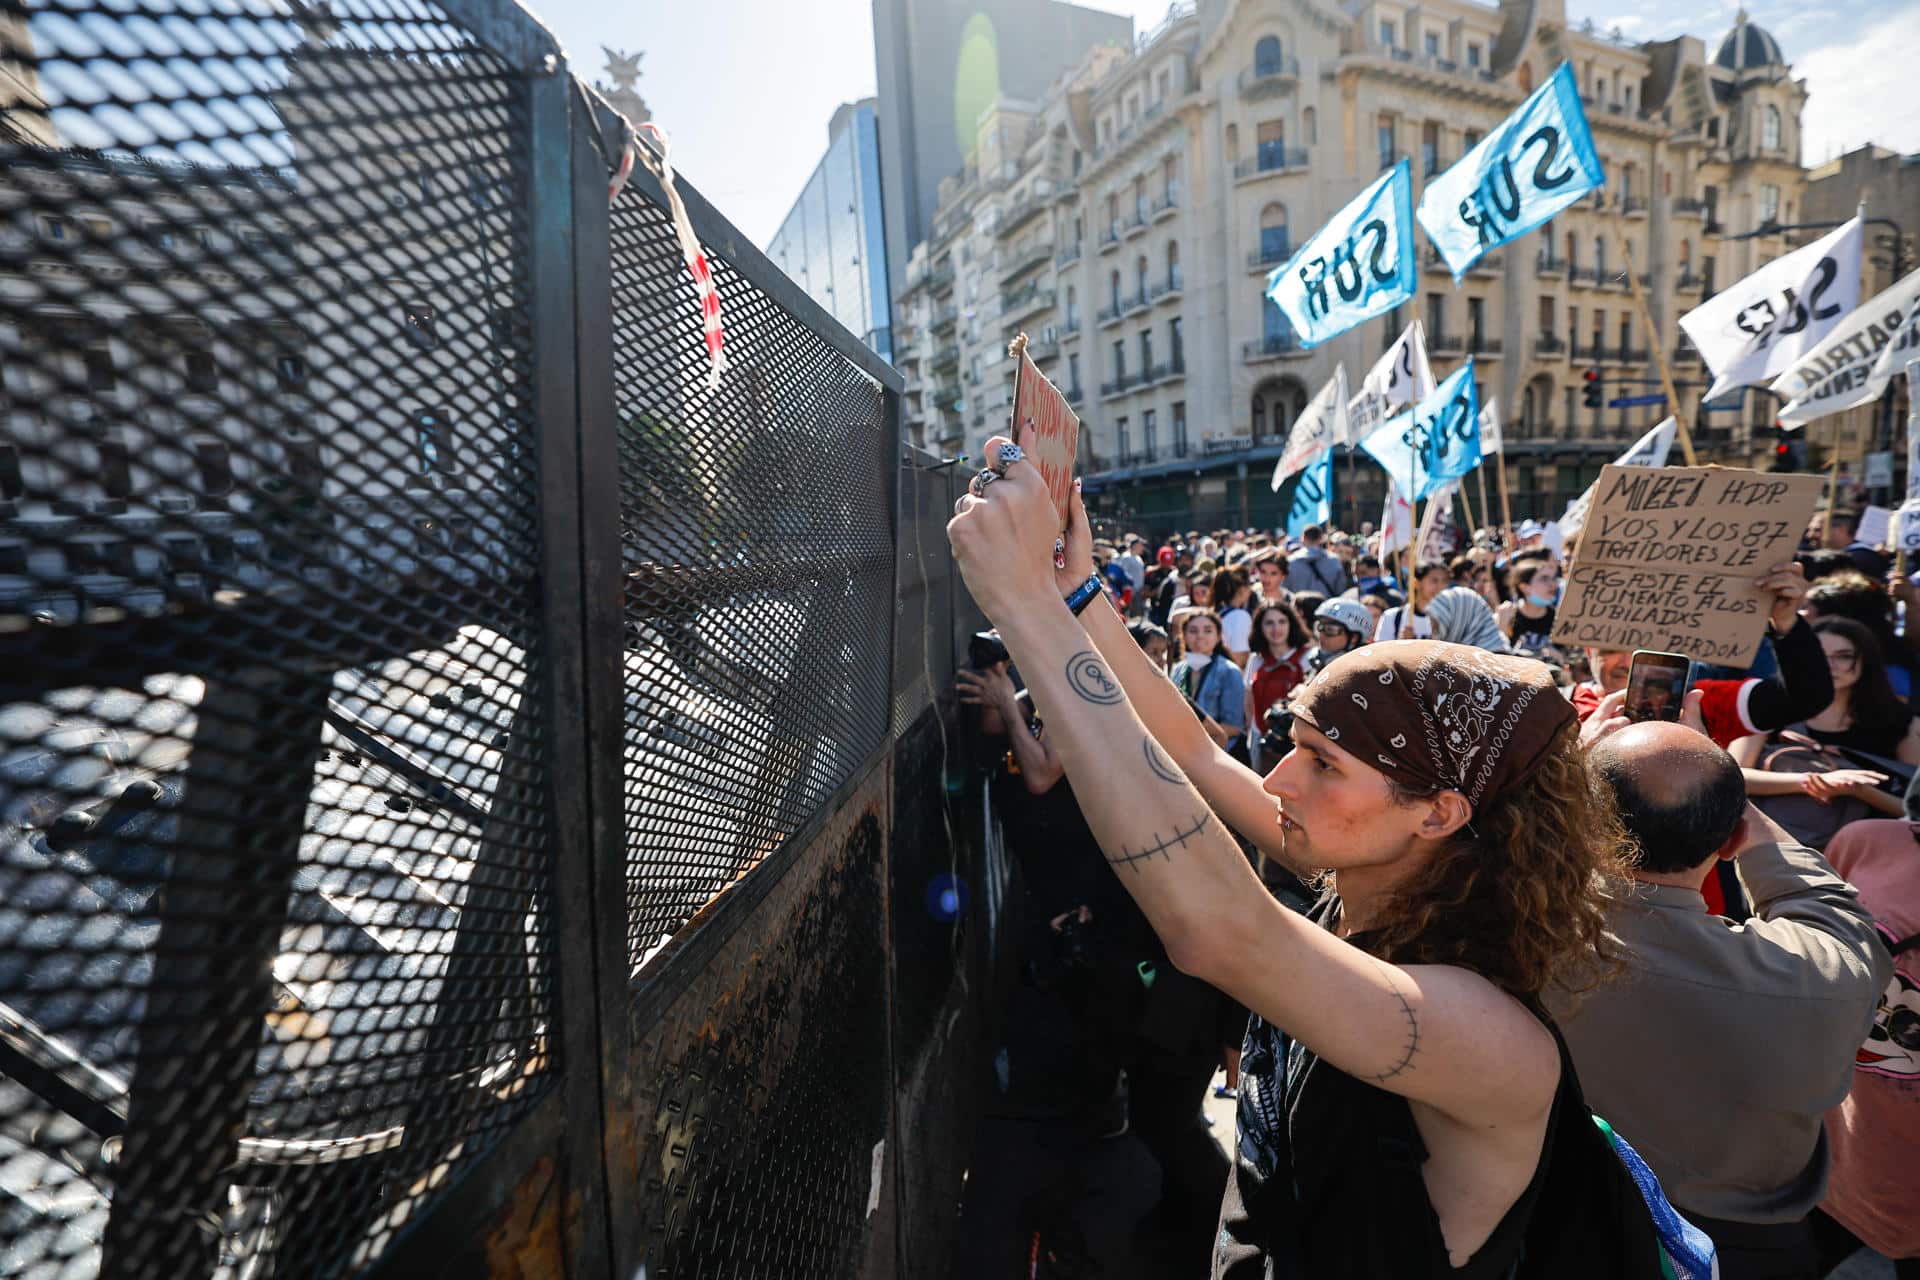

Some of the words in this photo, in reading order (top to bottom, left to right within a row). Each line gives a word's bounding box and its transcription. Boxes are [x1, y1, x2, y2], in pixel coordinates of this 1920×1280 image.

[1602, 514, 1659, 540] VOS
[1668, 519, 1689, 540] Y
[1688, 517, 1739, 541] LOS
[1742, 521, 1788, 549] 87
[1723, 548, 1759, 567] LE
[1574, 566, 1688, 591] CAGASTE
[1693, 576, 1727, 595] EL
[1582, 584, 1689, 608] AUMENTO
[1579, 623, 1653, 646] OLVIDO
